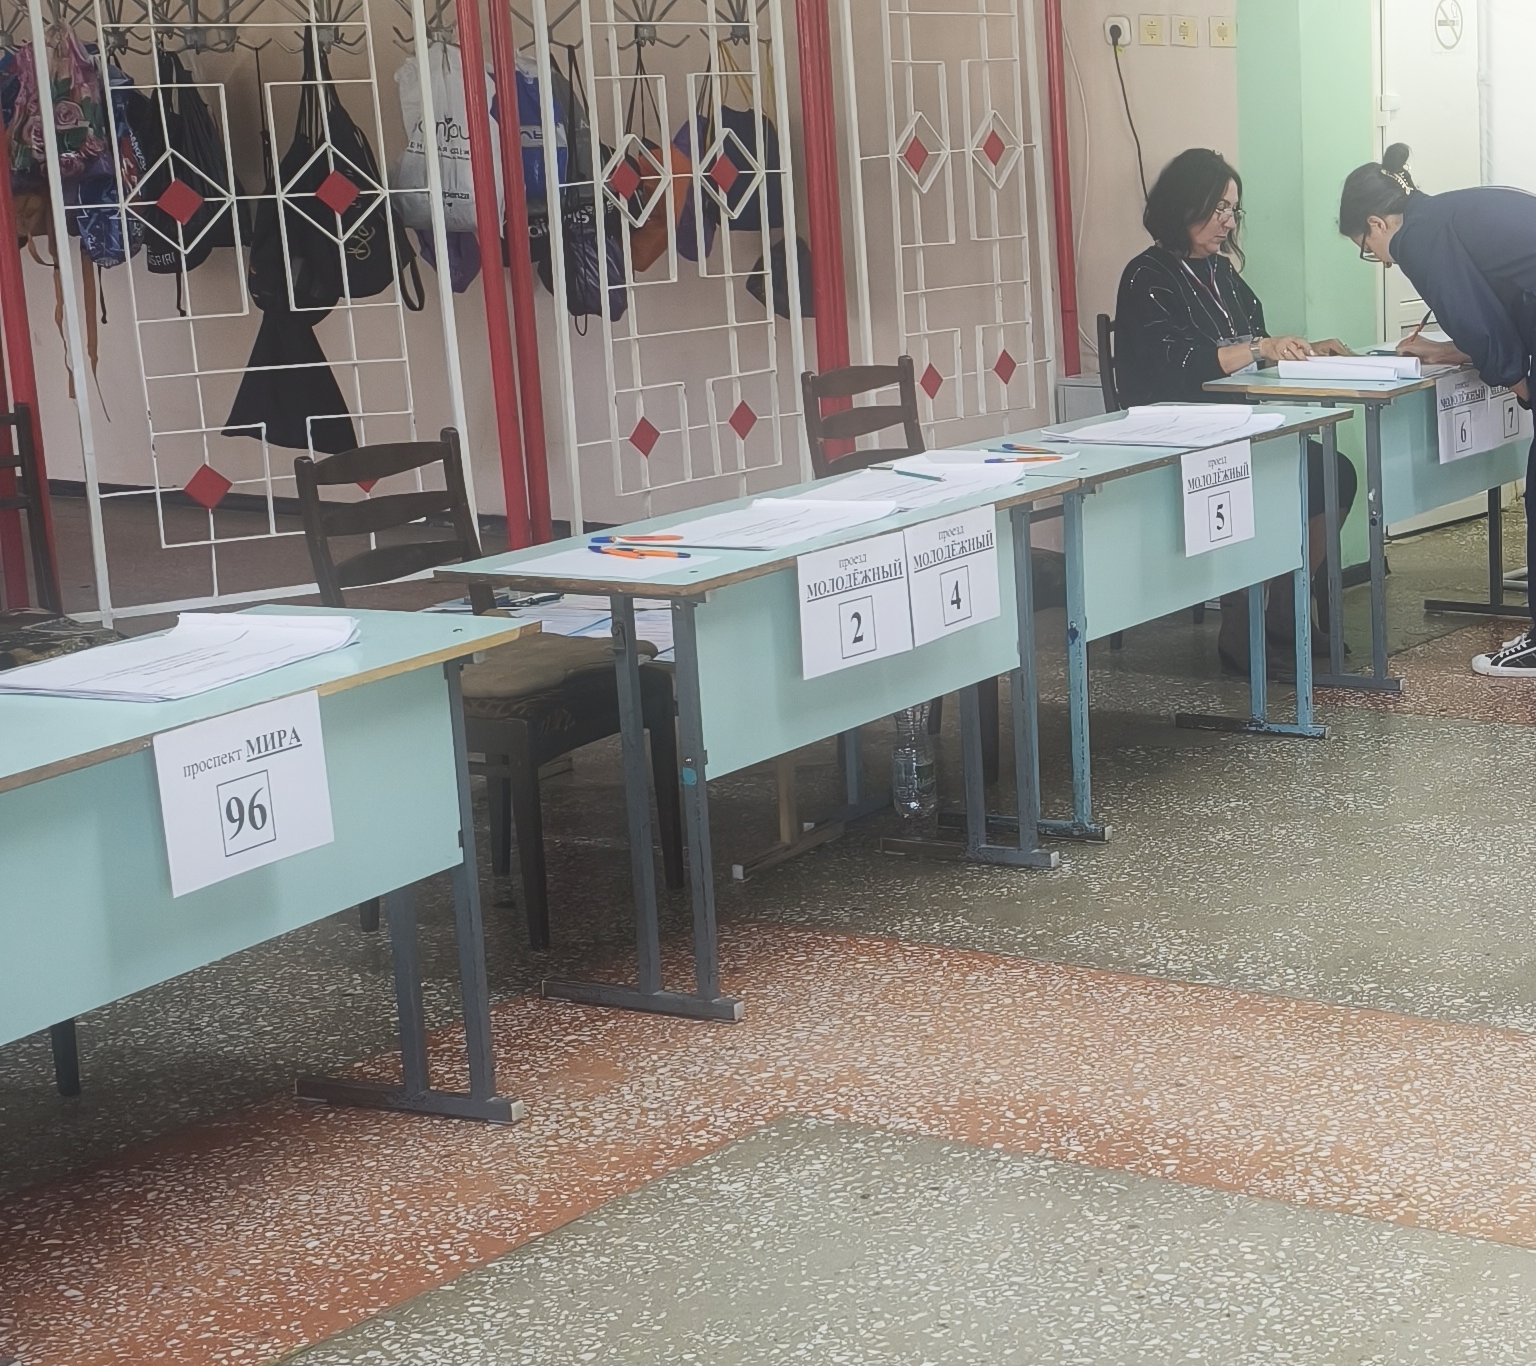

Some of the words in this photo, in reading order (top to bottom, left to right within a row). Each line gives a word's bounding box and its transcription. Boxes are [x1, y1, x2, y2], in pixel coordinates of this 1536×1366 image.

[1460, 418, 1467, 443] 6
[1507, 406, 1514, 429] 7
[1187, 461, 1250, 494] МОЛОДЁЖНЫЙ
[1216, 503, 1225, 531] 5
[913, 529, 994, 573] МОЛОДЁЖНЫЙ
[806, 558, 904, 602] МОЛОДЁЖНЫЙ
[950, 580, 962, 610] 4
[850, 611, 864, 644] 2
[182, 748, 243, 779] проспект
[245, 726, 303, 762] МИРА
[225, 786, 268, 841] 96
